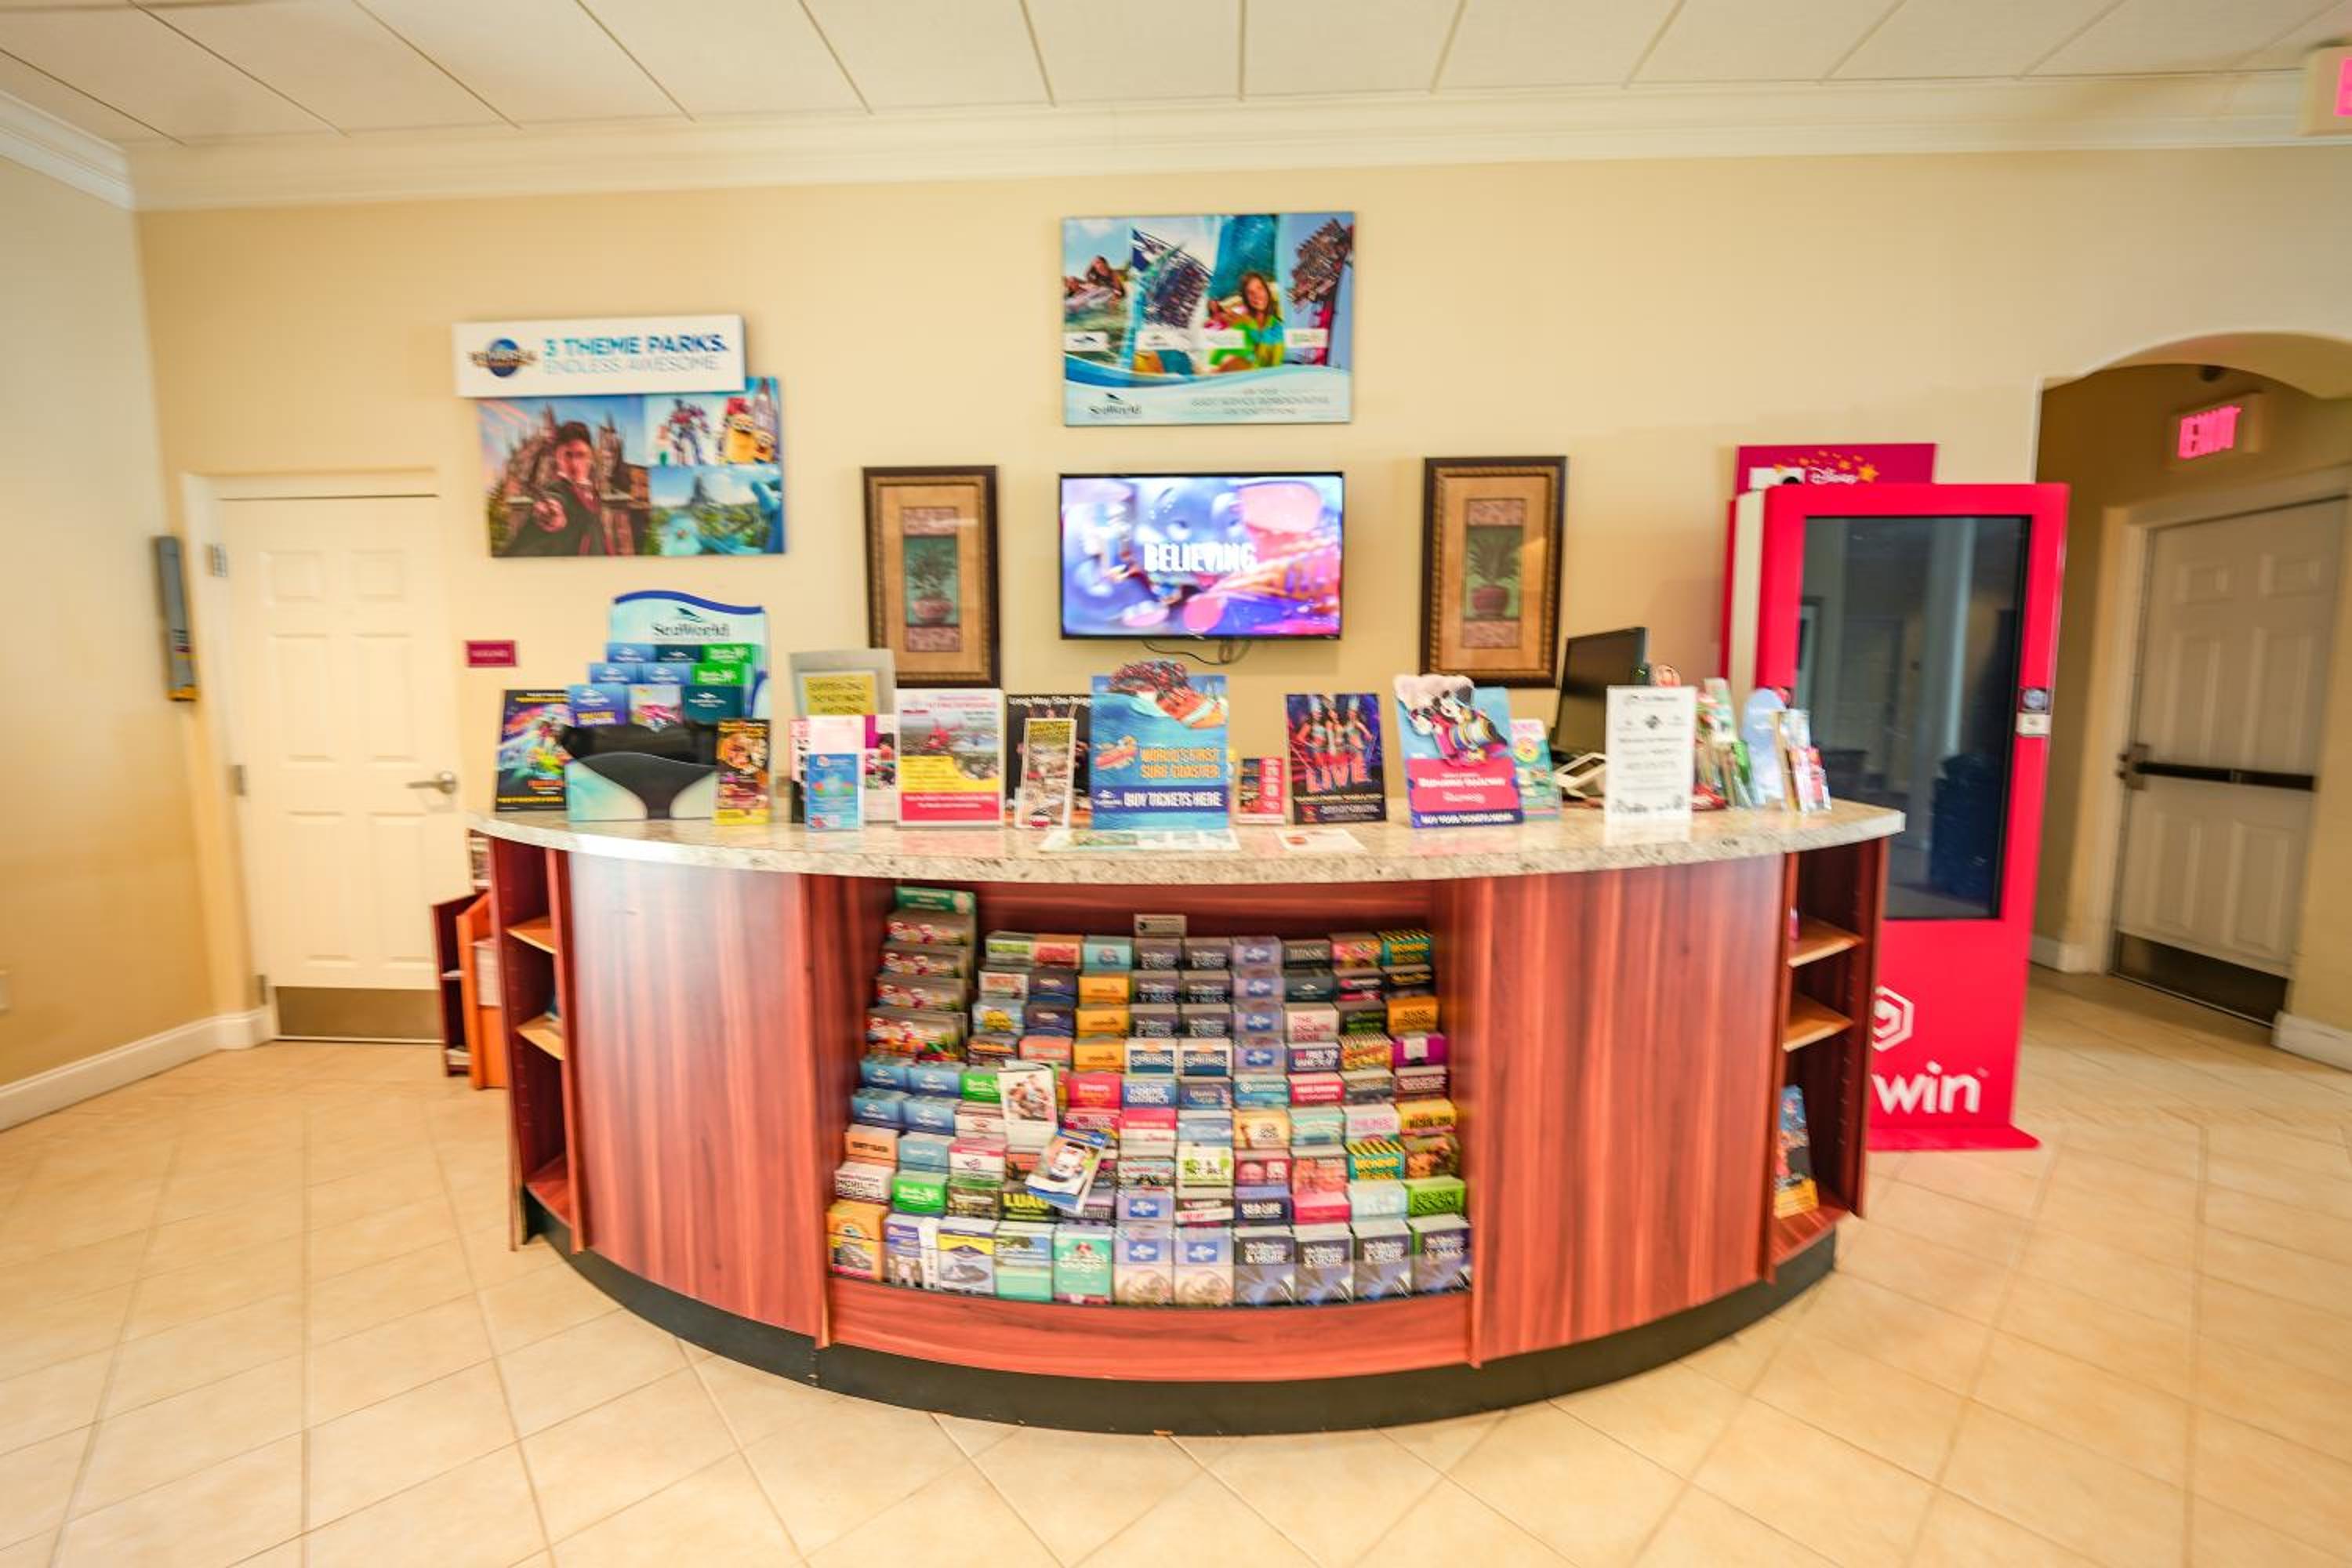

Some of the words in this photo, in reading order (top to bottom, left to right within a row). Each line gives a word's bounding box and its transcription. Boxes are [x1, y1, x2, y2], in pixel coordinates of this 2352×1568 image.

[544, 339, 556, 358] 3
[562, 336, 641, 356] THEME
[1142, 542, 1258, 573] BELIEVING
[652, 622, 731, 638] SeaWorld
[1305, 760, 1373, 793] LIVE
[1123, 791, 1148, 807] BUY
[1148, 791, 1192, 807] TICKETS
[1192, 791, 1223, 806] HERE
